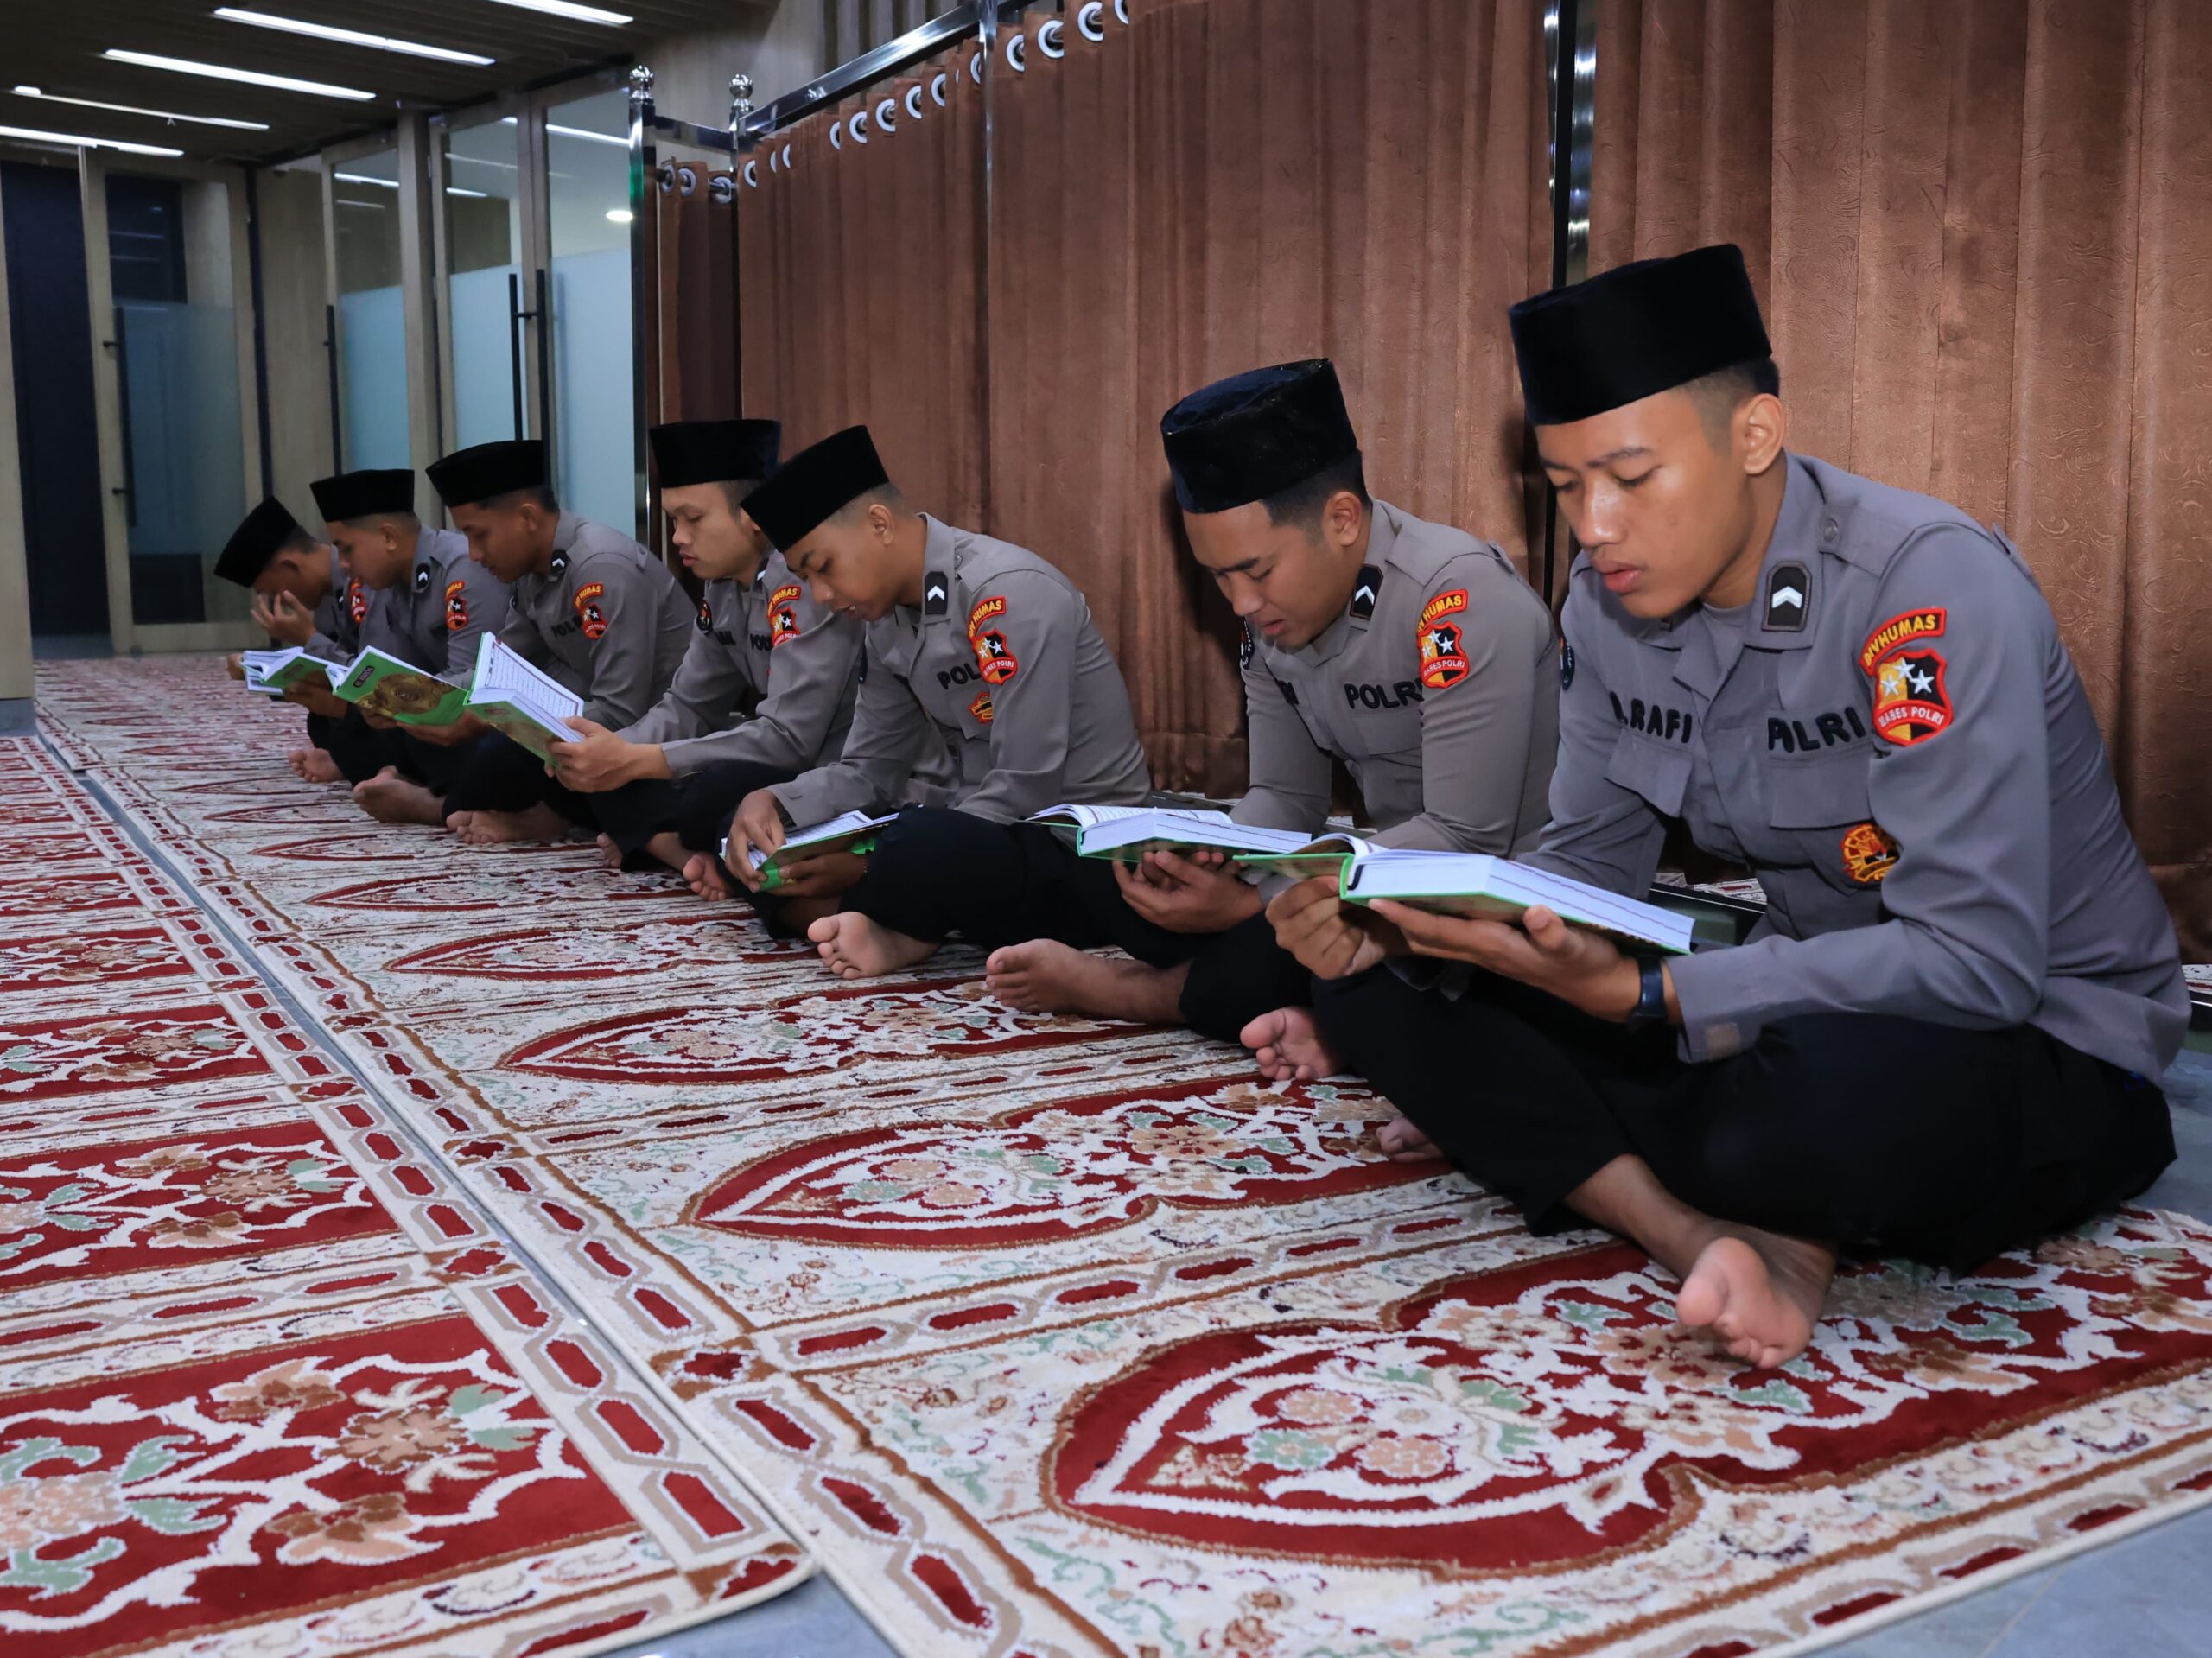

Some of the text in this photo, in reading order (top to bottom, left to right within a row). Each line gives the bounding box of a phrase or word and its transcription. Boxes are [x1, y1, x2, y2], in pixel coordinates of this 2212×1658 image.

[1441, 658, 1465, 668] POLRI
[937, 657, 982, 690] POL
[1910, 707, 1944, 725] POLRI
